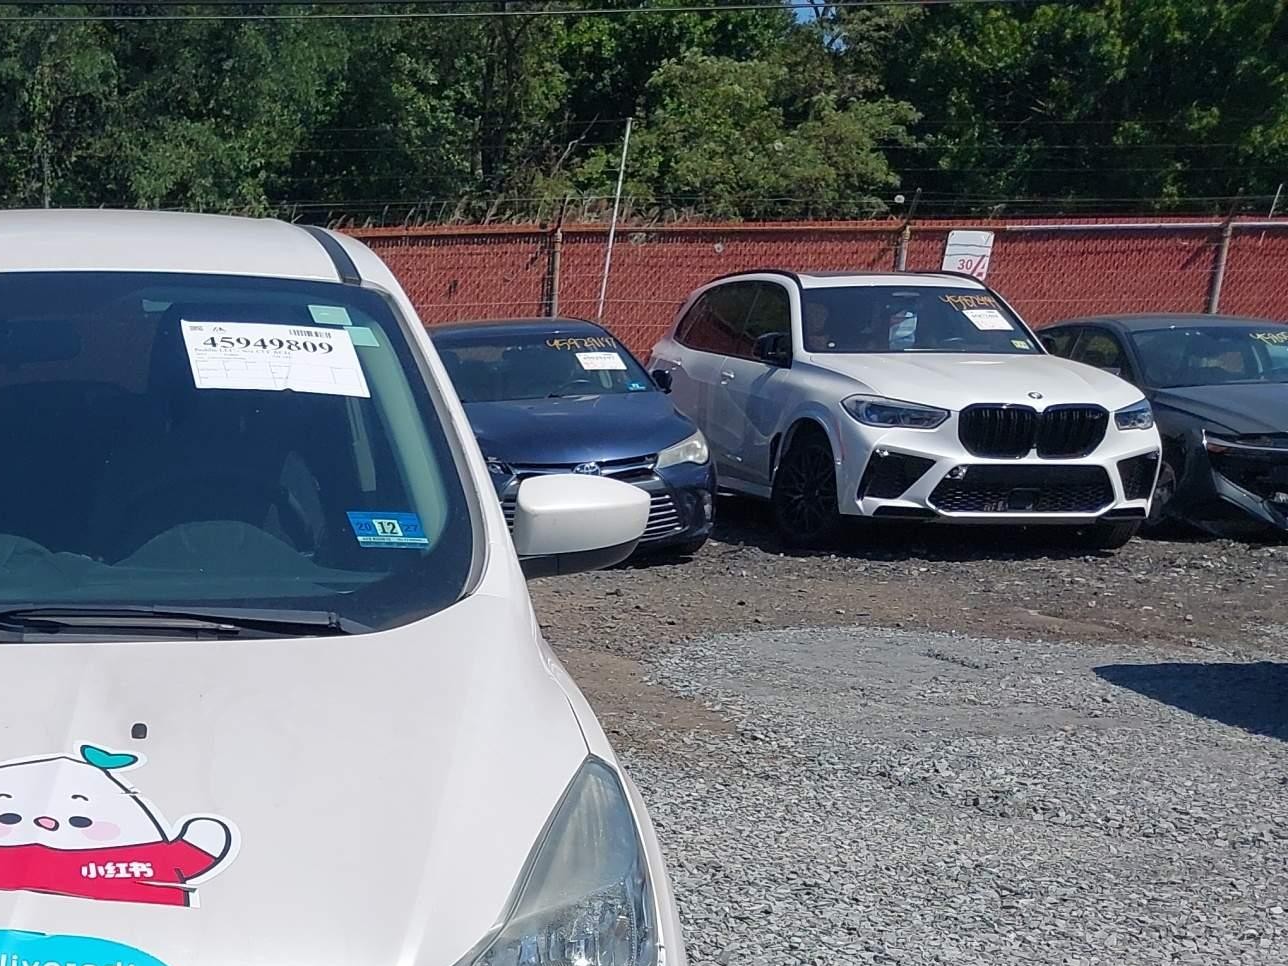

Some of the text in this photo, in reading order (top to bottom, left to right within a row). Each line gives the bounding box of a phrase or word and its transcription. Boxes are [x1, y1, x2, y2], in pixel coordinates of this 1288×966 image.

[202, 336, 334, 355] 45949809
[377, 521, 399, 535] 12
[81, 862, 154, 879] 小红书
